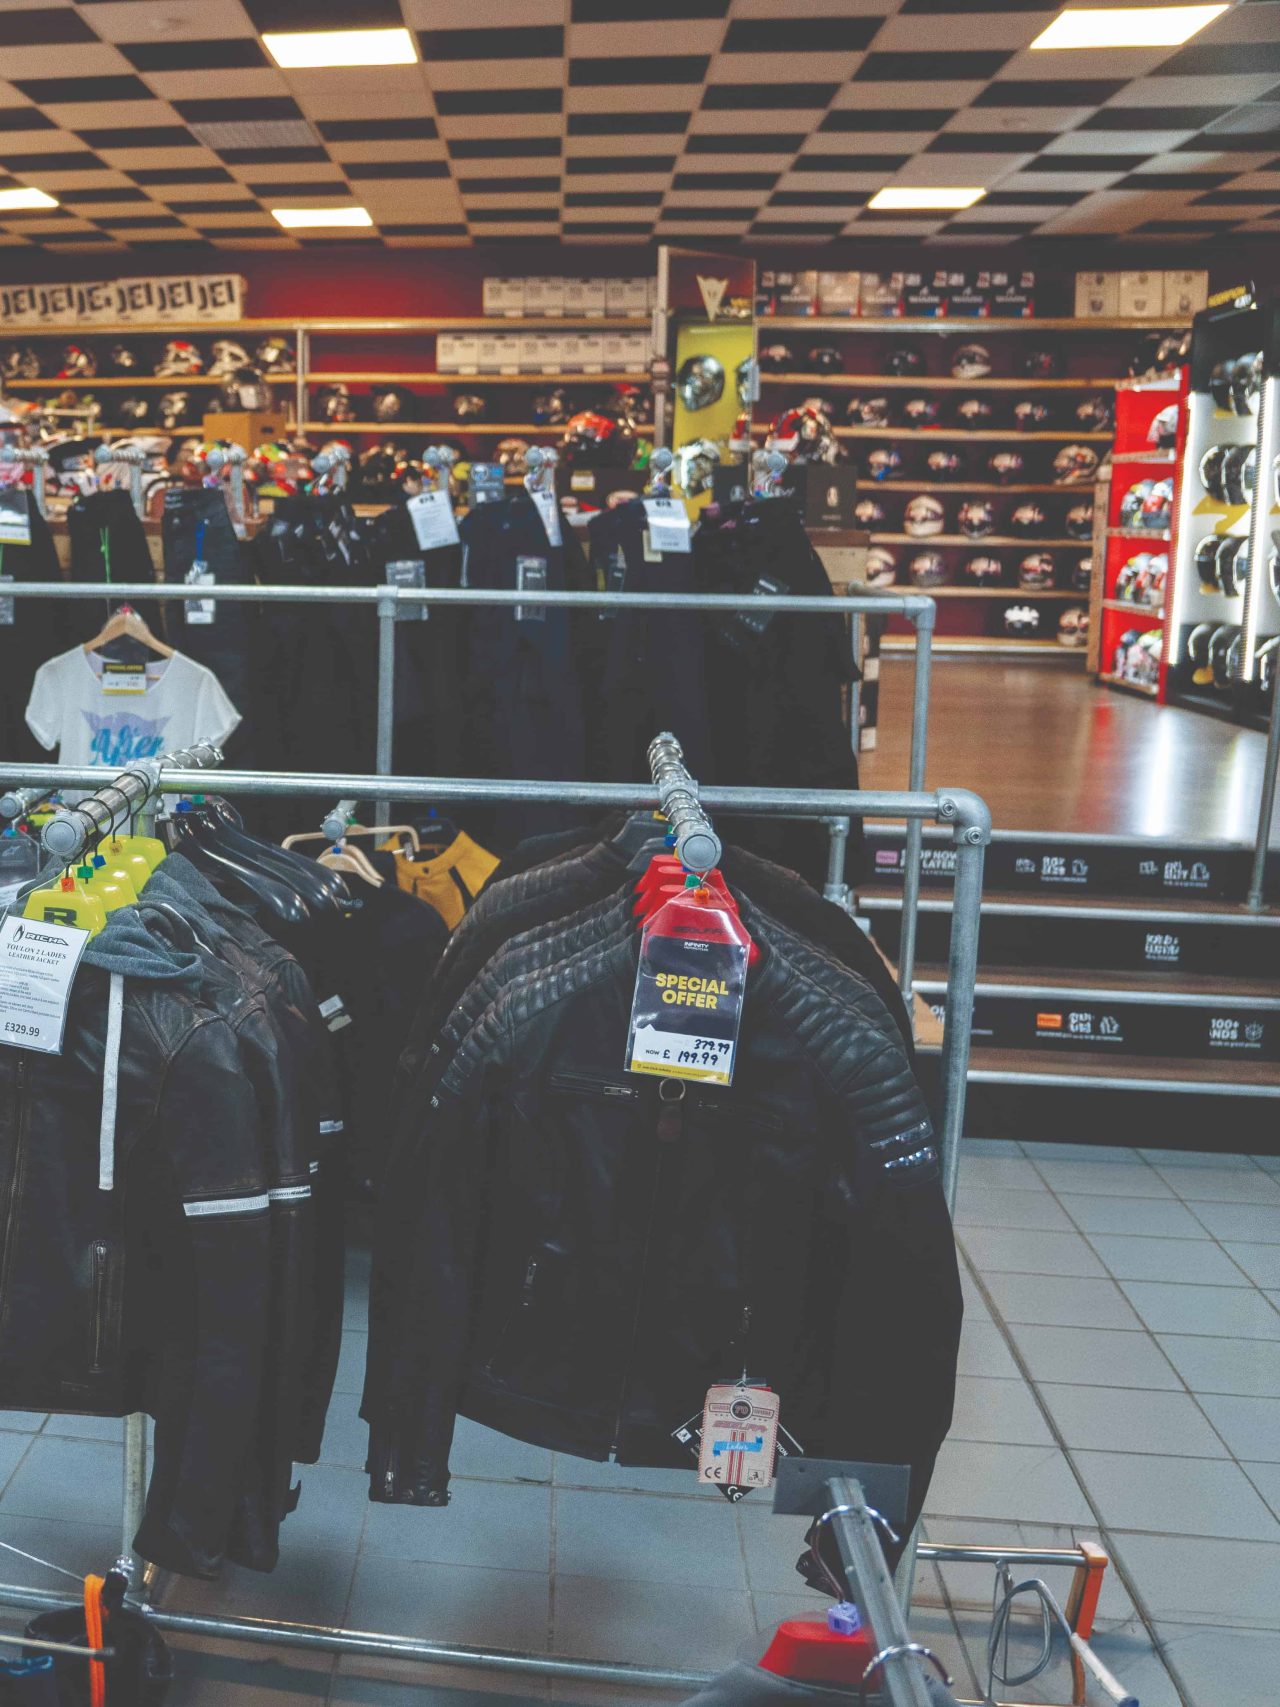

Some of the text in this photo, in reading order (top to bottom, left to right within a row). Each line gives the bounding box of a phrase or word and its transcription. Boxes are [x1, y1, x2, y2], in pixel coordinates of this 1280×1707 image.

[25, 931, 69, 946] RICHA
[6, 943, 35, 954] TOULON
[41, 949, 67, 960] LADIES
[8, 952, 60, 966] LEATHER JACKET
[655, 972, 729, 996] SPECIAL
[662, 990, 719, 1010] OFFER
[5, 1021, 40, 1037] £329.99
[694, 1038, 730, 1056] 379.99
[663, 1049, 671, 1059] £
[677, 1050, 719, 1067] 199.99
[704, 1466, 722, 1479] CE
